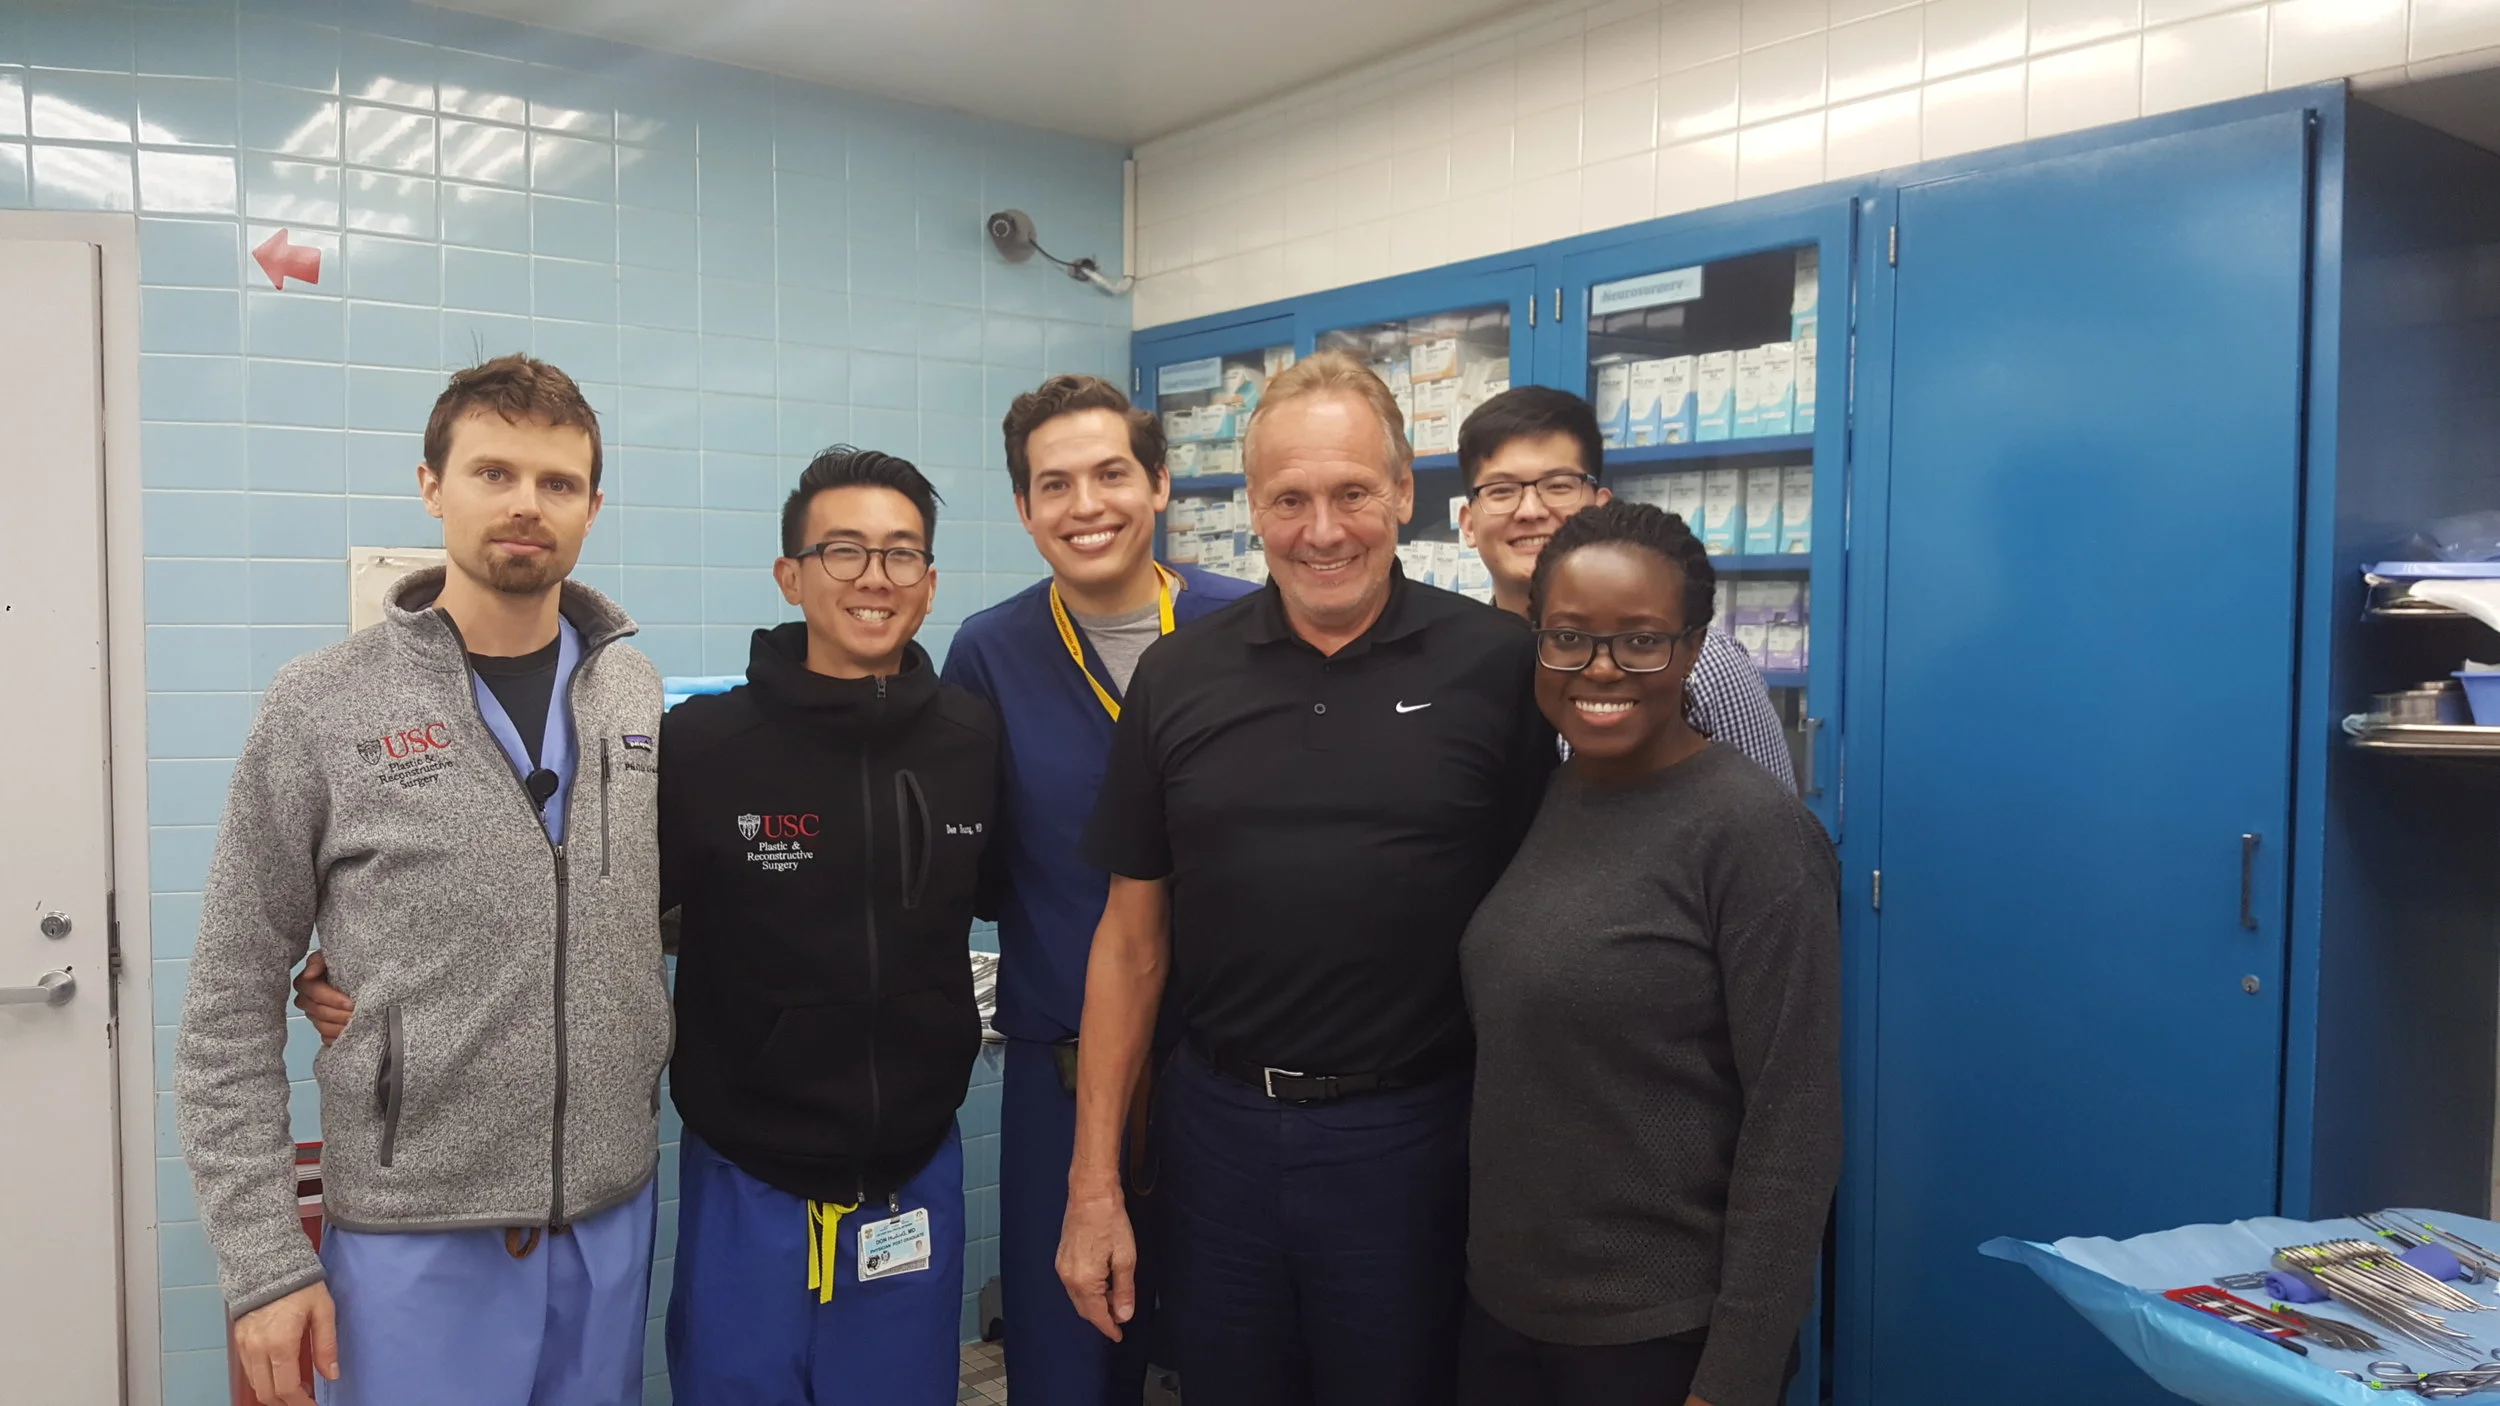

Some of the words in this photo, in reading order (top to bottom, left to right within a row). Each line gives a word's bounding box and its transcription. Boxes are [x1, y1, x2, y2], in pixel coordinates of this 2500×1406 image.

[381, 723, 451, 758] USC
[389, 758, 423, 773] Plastic
[425, 754, 435, 763] &
[379, 760, 454, 785] Reconstructive
[399, 774, 439, 789] Surgery
[762, 814, 820, 838] USC
[759, 841, 788, 852] Plastic
[791, 841, 801, 850] &
[747, 851, 814, 861] Reconstructive
[762, 861, 799, 872] Surgery
